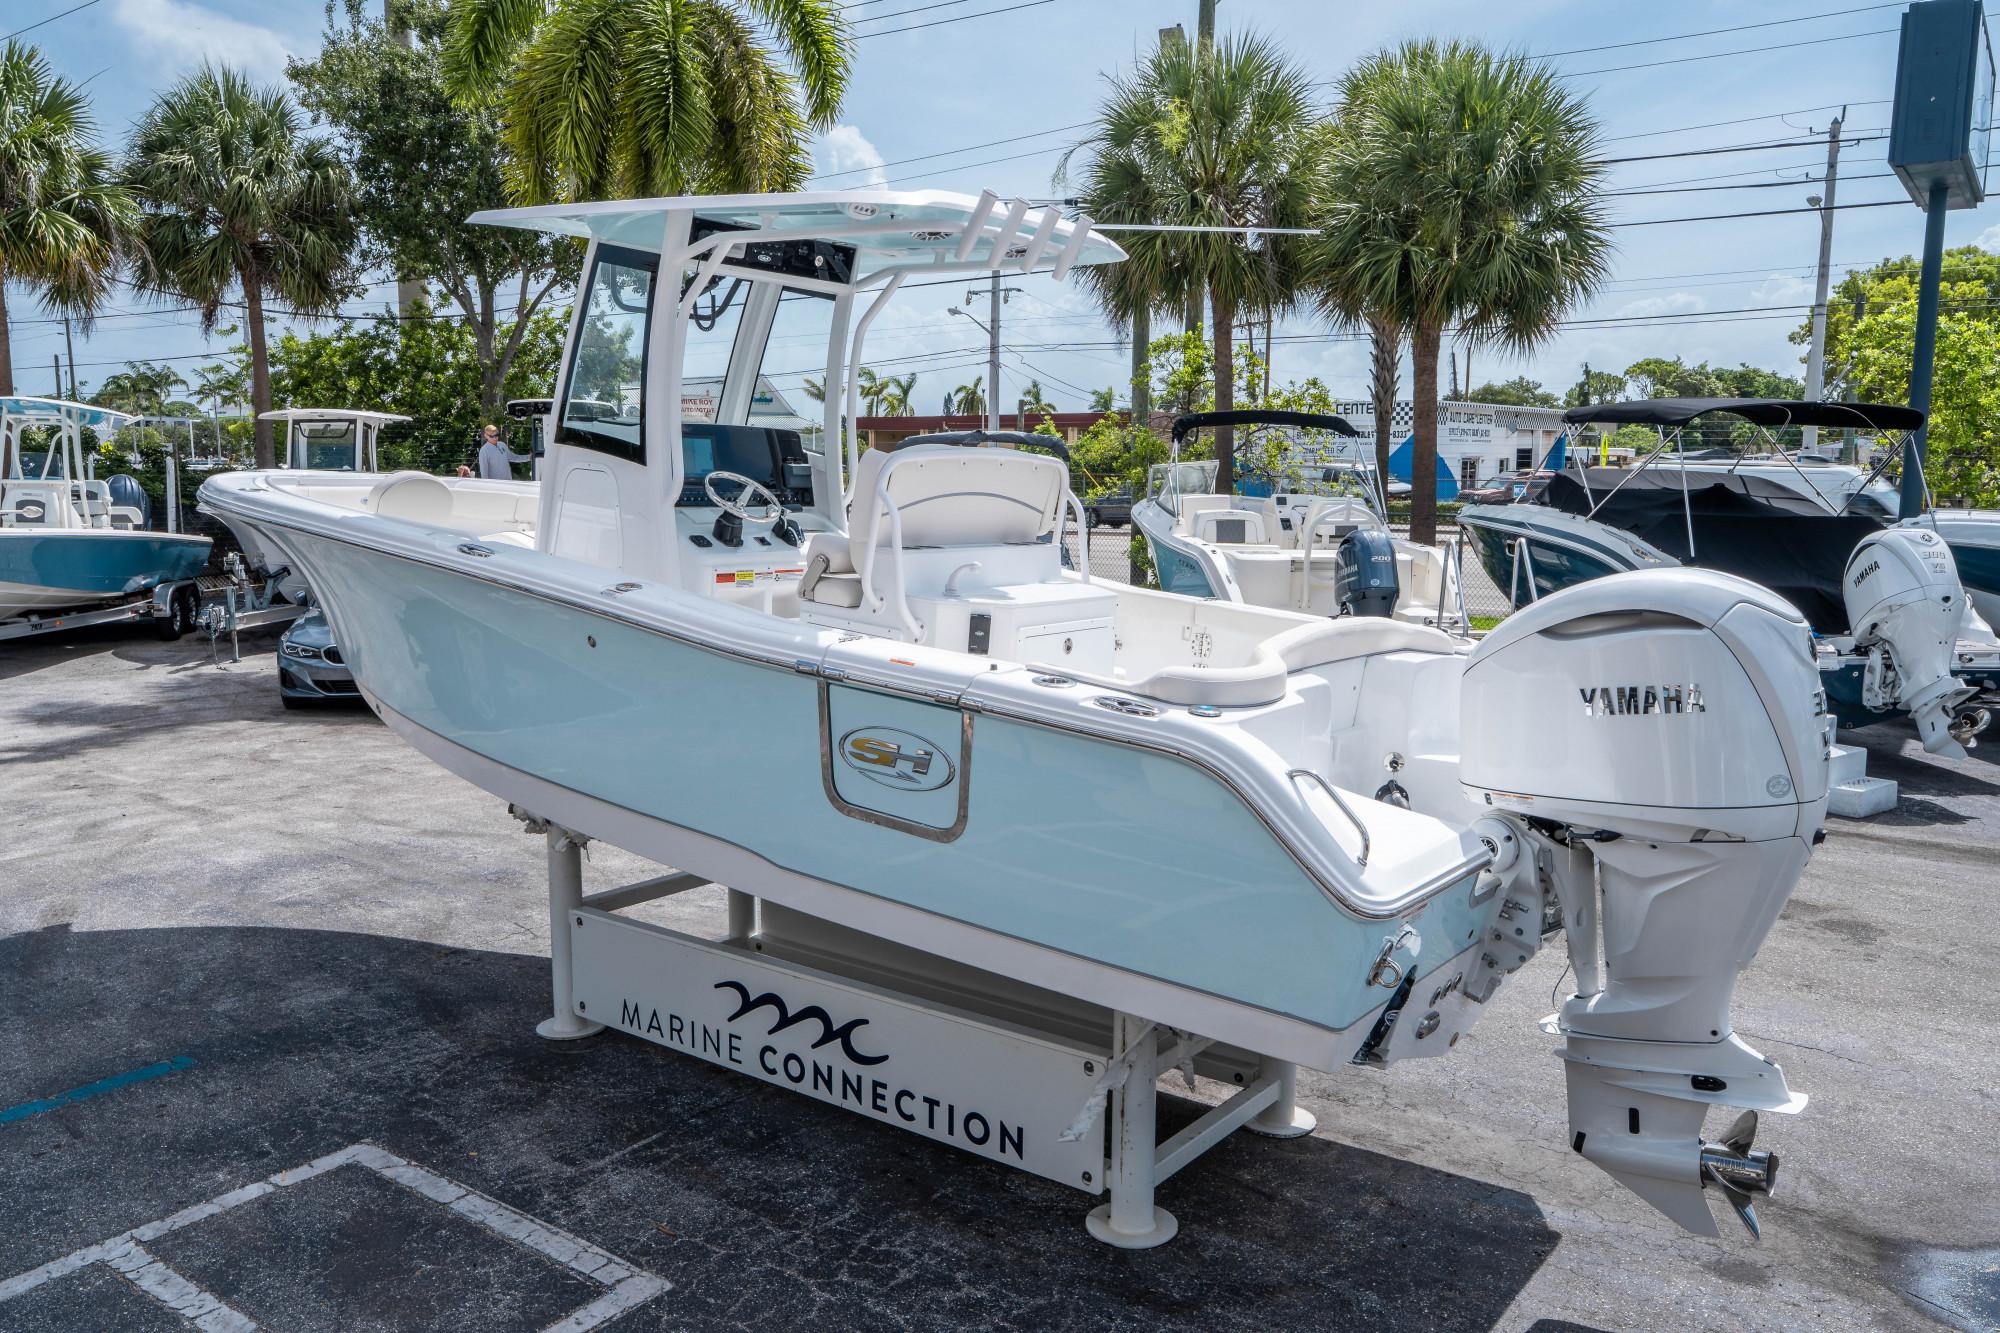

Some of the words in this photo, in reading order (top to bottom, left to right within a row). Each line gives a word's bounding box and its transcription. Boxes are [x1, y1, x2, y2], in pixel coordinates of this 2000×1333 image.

[1336, 402, 1374, 415] CENTE
[1853, 560, 1880, 588] YAMAHA
[1579, 682, 1706, 718] YAMAHA
[621, 998, 743, 1065] MARINE
[758, 1045, 1024, 1160] CONNECTION
